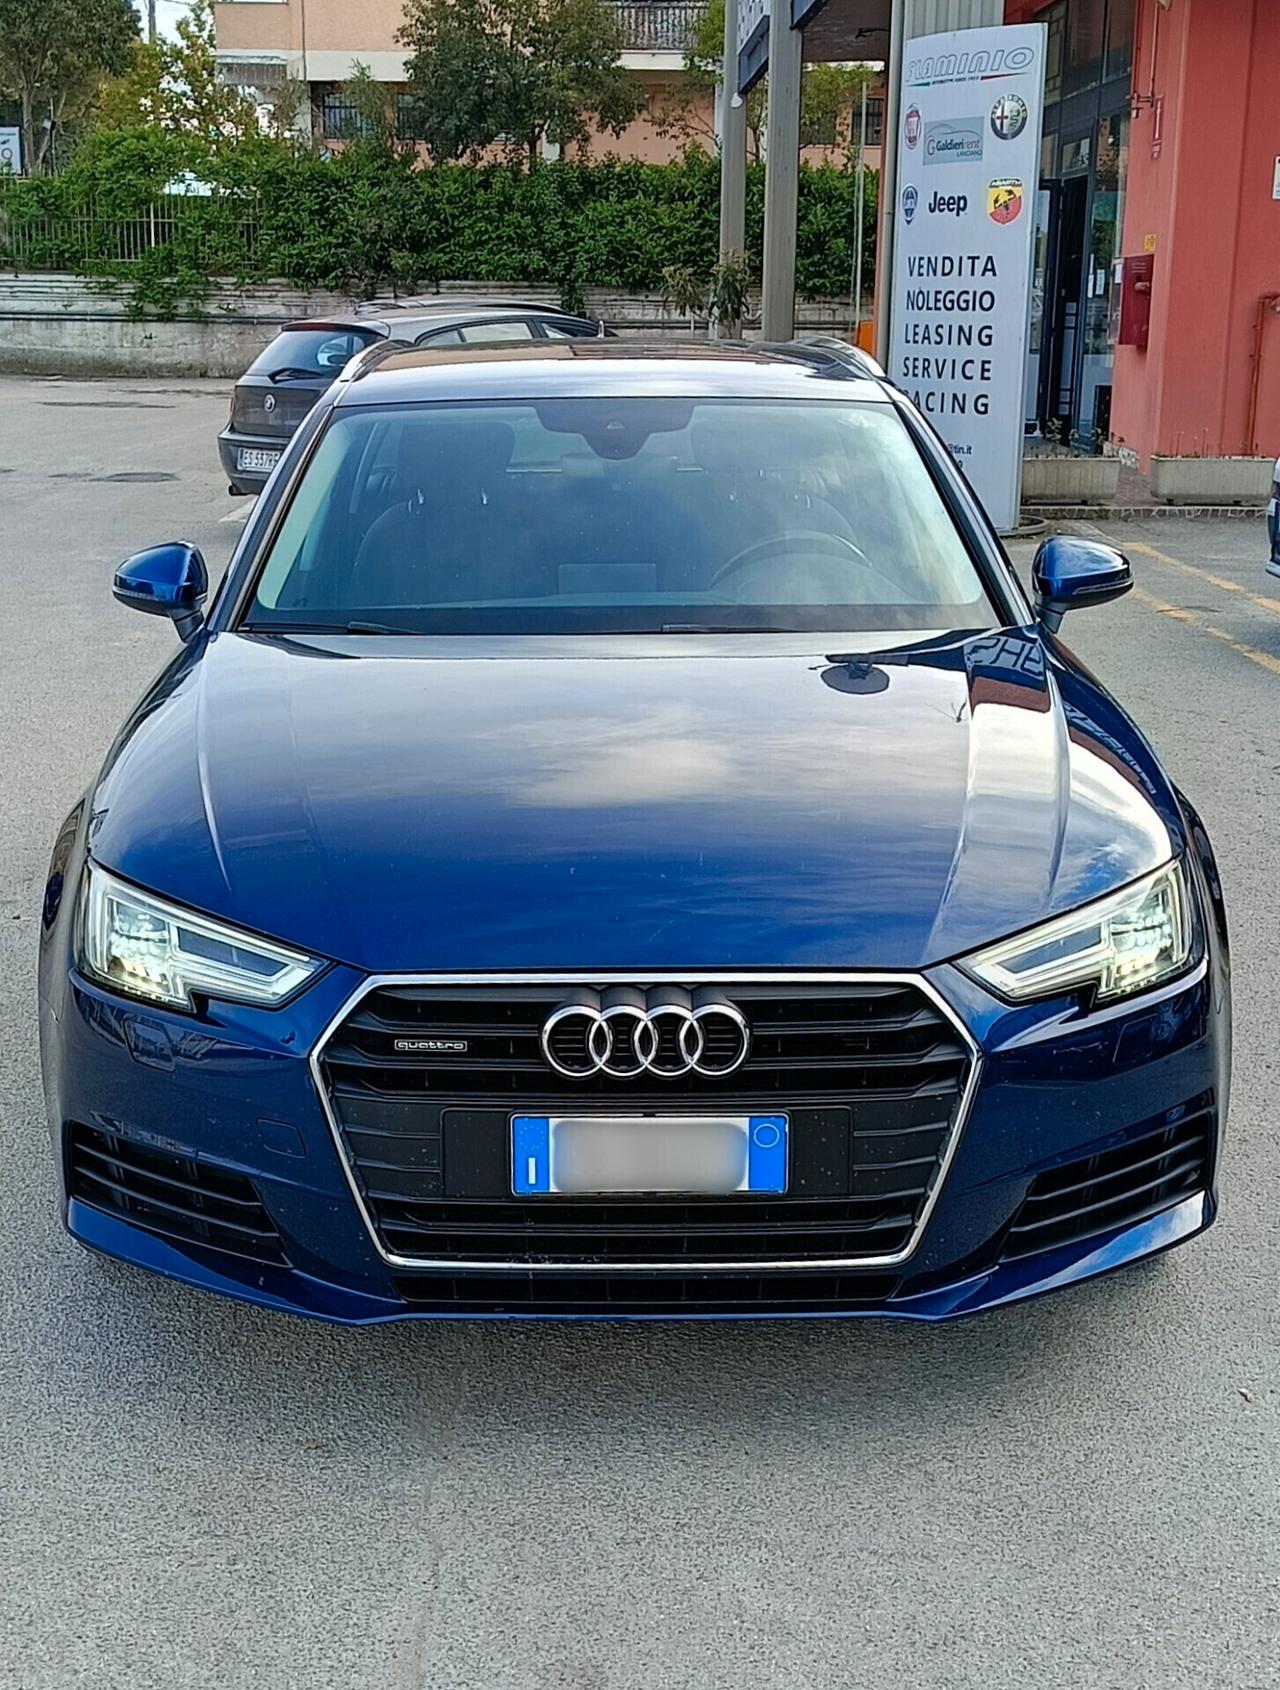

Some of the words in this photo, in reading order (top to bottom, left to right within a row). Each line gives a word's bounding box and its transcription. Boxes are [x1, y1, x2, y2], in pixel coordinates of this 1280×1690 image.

[905, 46, 1034, 82] FLAMINIO
[928, 191, 967, 217] Jeep
[907, 255, 998, 277] VENDITA
[906, 290, 995, 312] NOLEGGIO
[904, 323, 993, 347] LEASING
[902, 356, 992, 381] SERVICE
[903, 390, 989, 415] ACING
[397, 1041, 464, 1050] quattro
